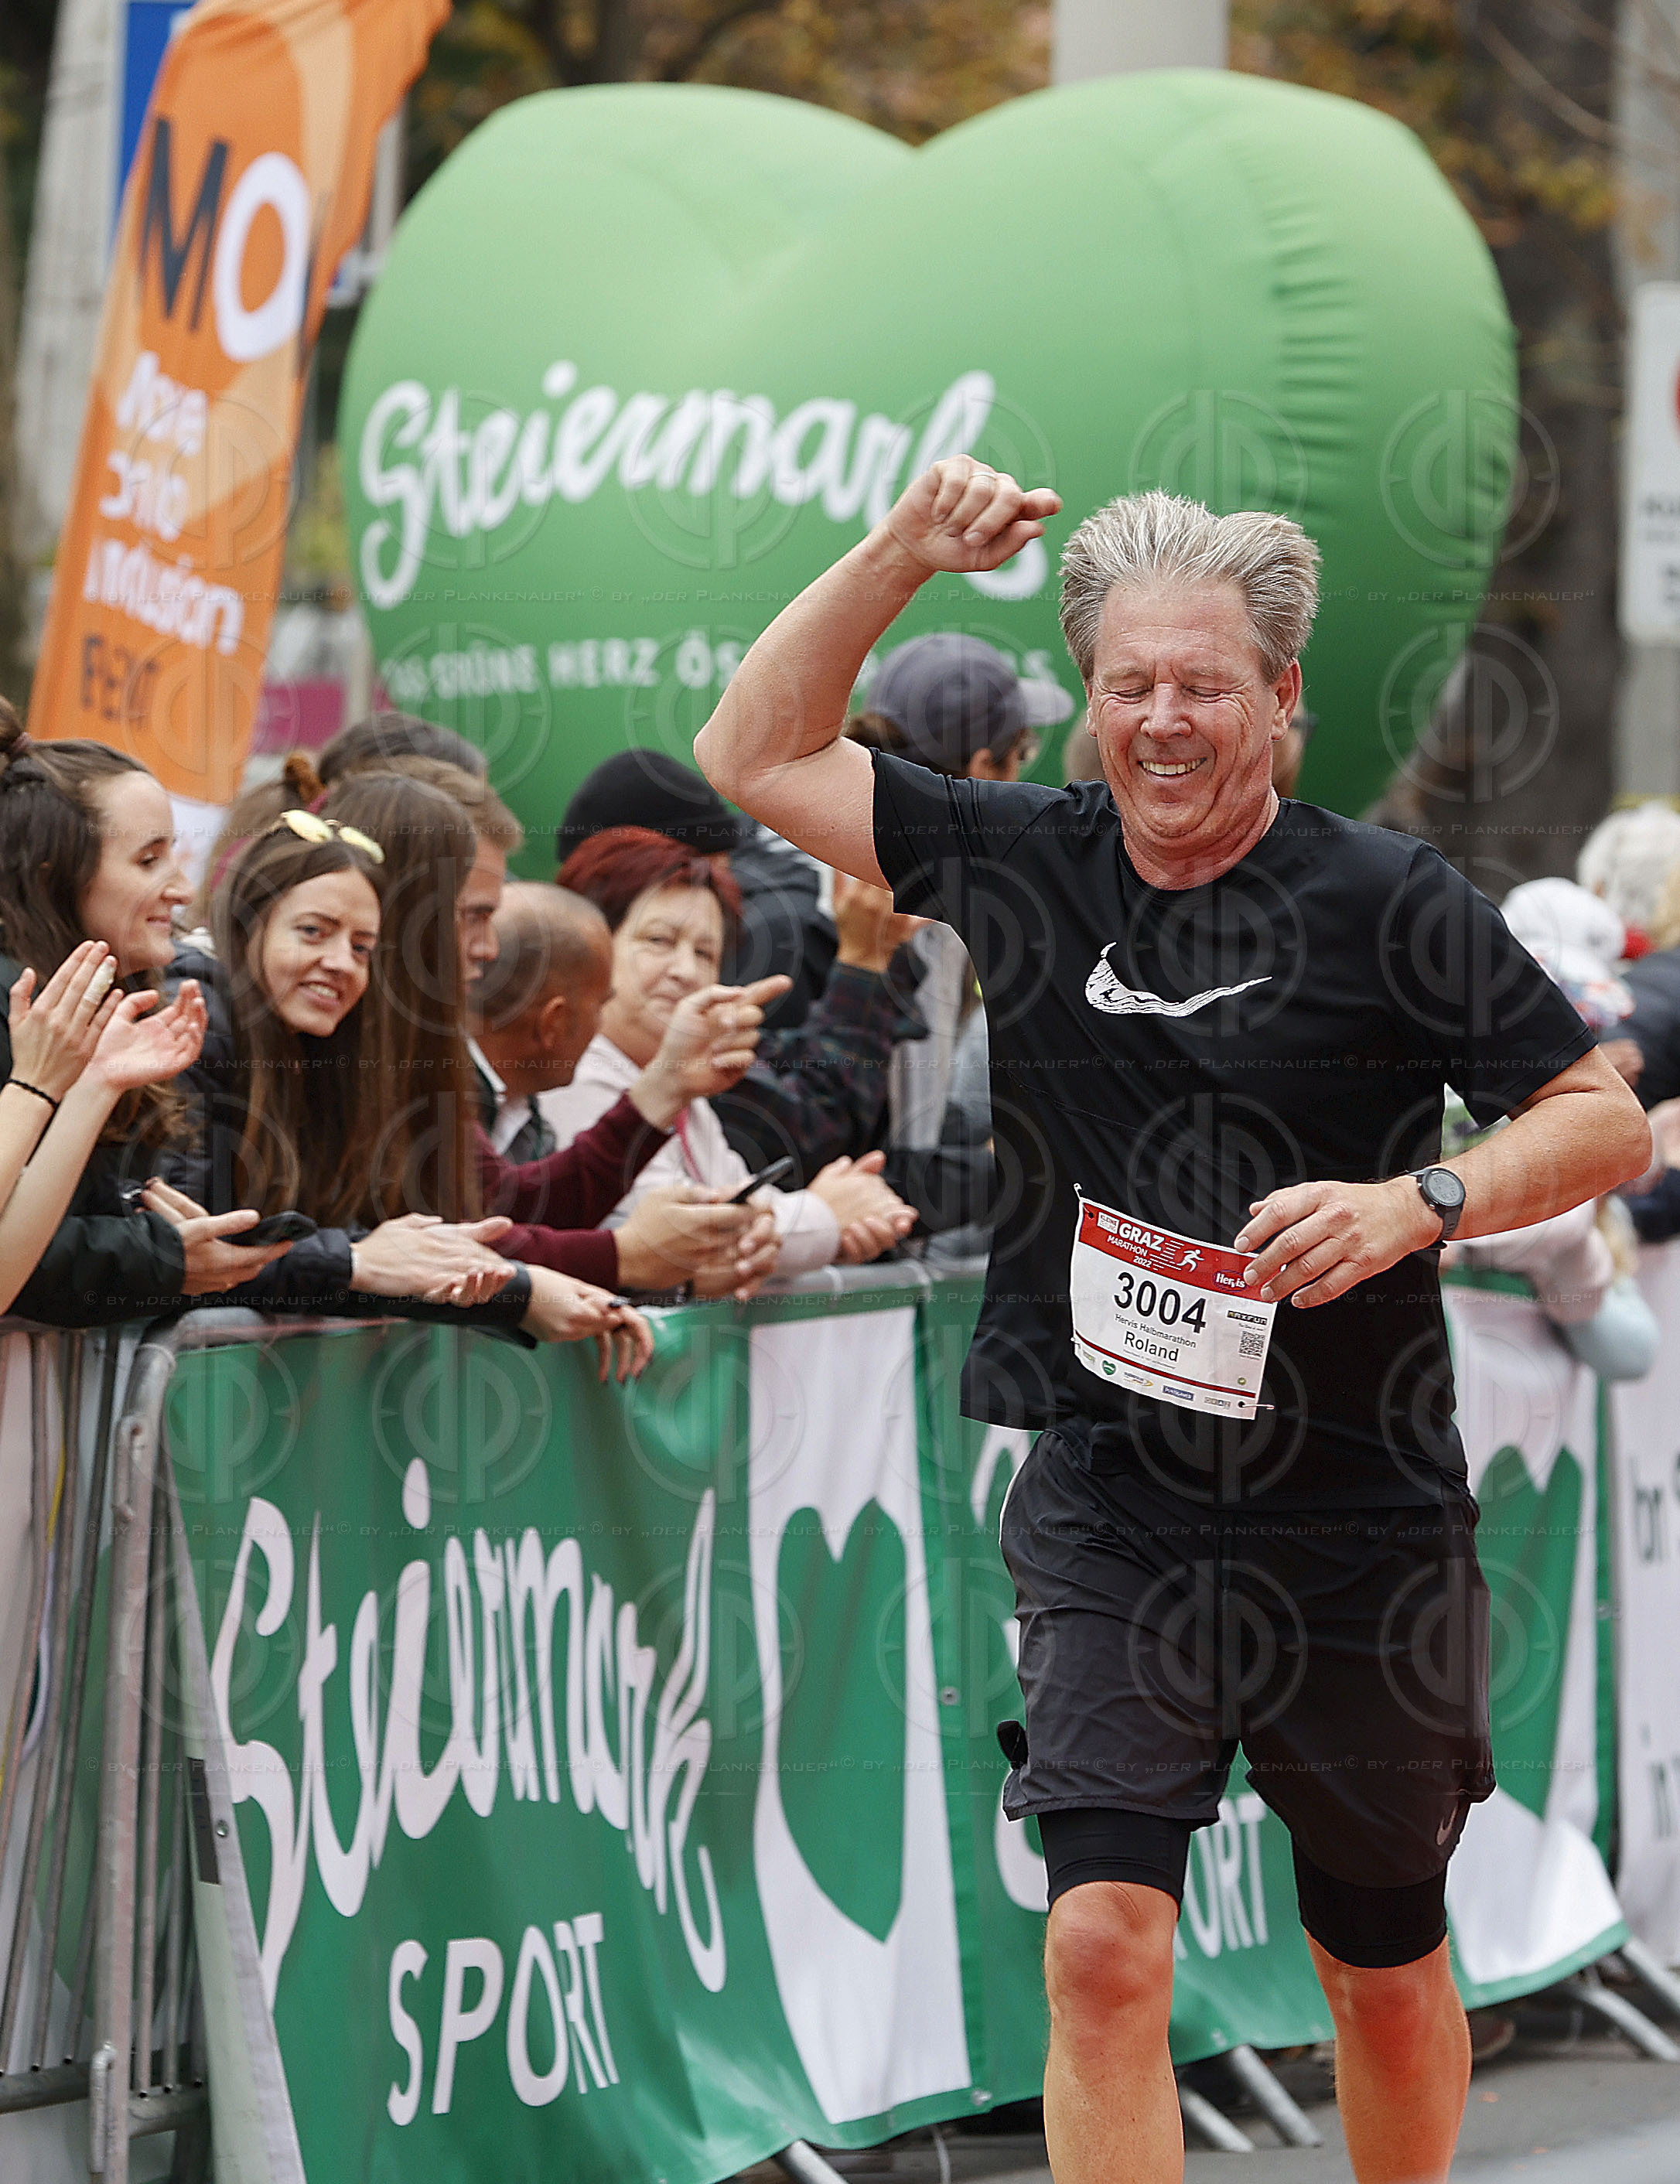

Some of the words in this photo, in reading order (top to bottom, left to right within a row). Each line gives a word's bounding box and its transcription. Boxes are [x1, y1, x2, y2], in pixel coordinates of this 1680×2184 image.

[548, 638, 660, 688] HERZ
[1107, 1235, 1148, 1257] MARATHON
[1119, 1223, 1165, 1251] GRAZ
[1133, 1256, 1152, 1268] 2022
[1215, 1273, 1245, 1288] Hervis
[1114, 1272, 1207, 1334] 3004
[1115, 1313, 1139, 1329] Hervis
[1139, 1323, 1197, 1348] Halbmarathon
[1124, 1331, 1180, 1362] Roland
[210, 1457, 728, 2016] Steiermark
[388, 1912, 618, 2126] SPORT
